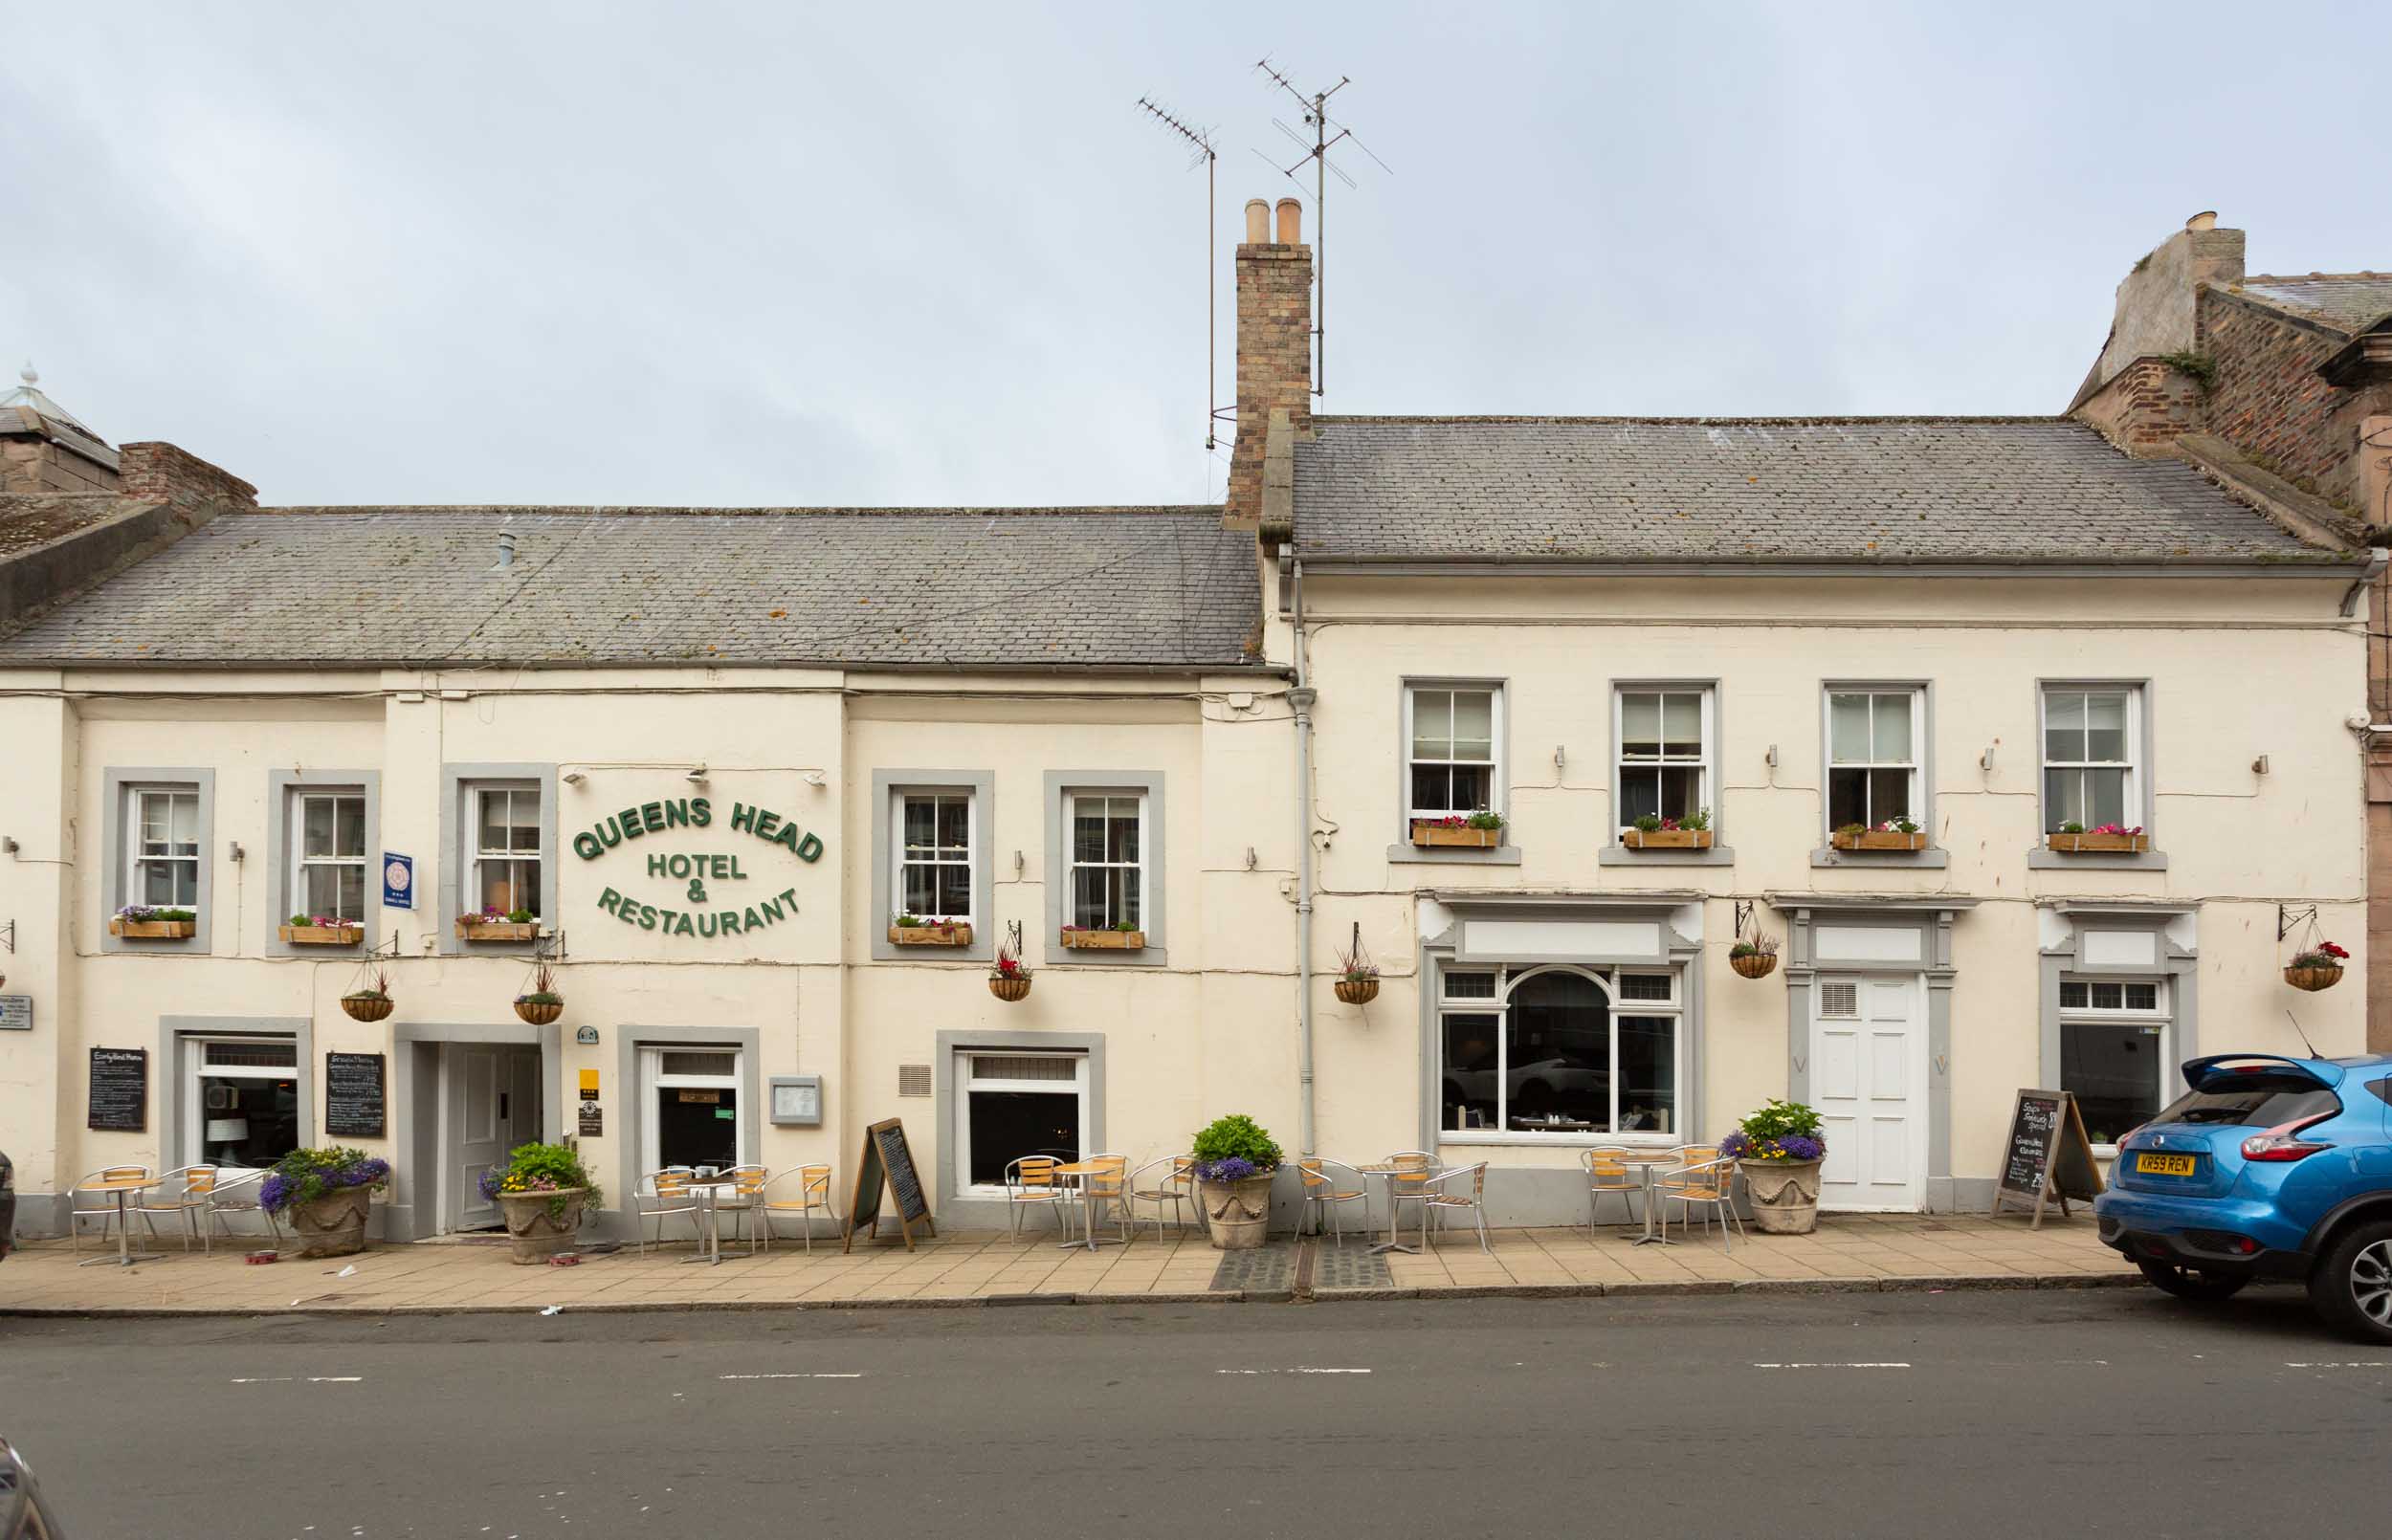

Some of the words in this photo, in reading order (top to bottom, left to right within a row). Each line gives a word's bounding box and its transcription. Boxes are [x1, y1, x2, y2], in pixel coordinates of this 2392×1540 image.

[573, 798, 712, 860] QUEENS
[730, 802, 824, 863] HEAD
[648, 853, 747, 879] HOTEL
[687, 878, 707, 903] &
[597, 887, 800, 937] RESTAURANT
[2141, 1155, 2166, 1171] KR59
[2168, 1156, 2190, 1172] REN
